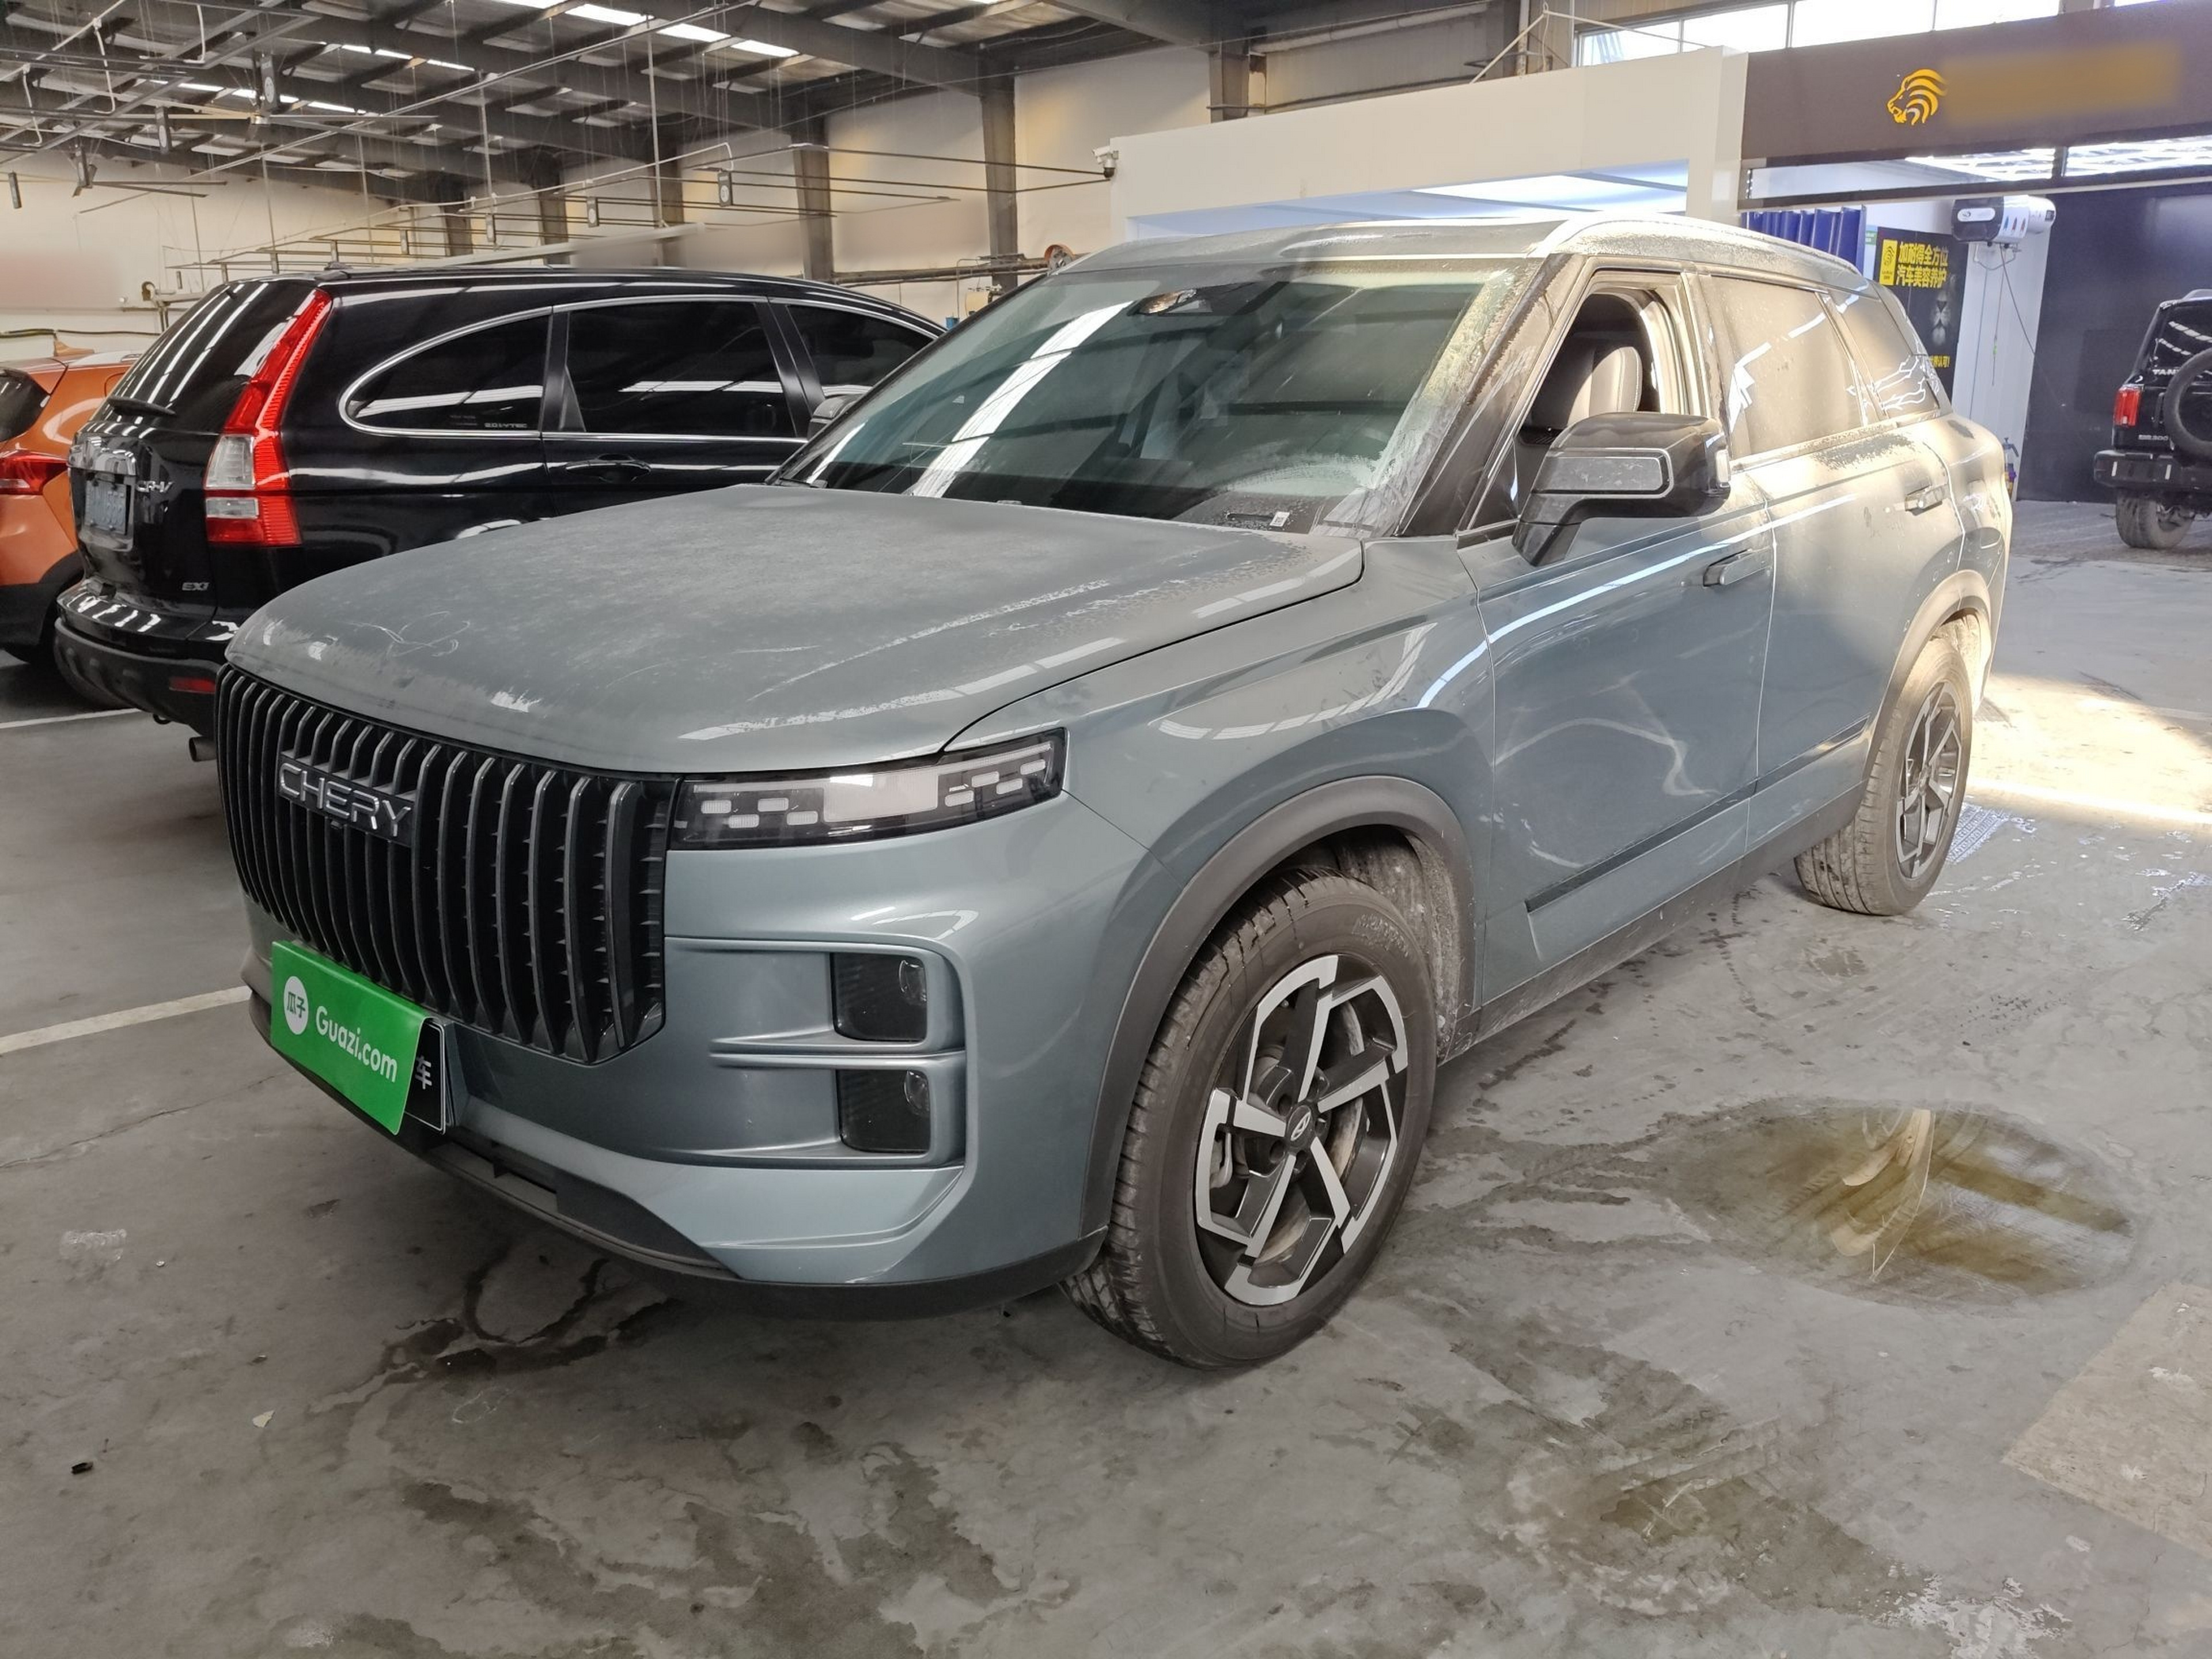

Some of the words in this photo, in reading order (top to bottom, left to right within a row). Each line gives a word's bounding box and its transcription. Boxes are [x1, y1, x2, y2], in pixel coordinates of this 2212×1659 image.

[1896, 264, 1946, 289] 汽车美容养护
[279, 762, 411, 836] CHERY
[287, 991, 306, 1018] 瓜子
[316, 1006, 397, 1083] Guazi.com
